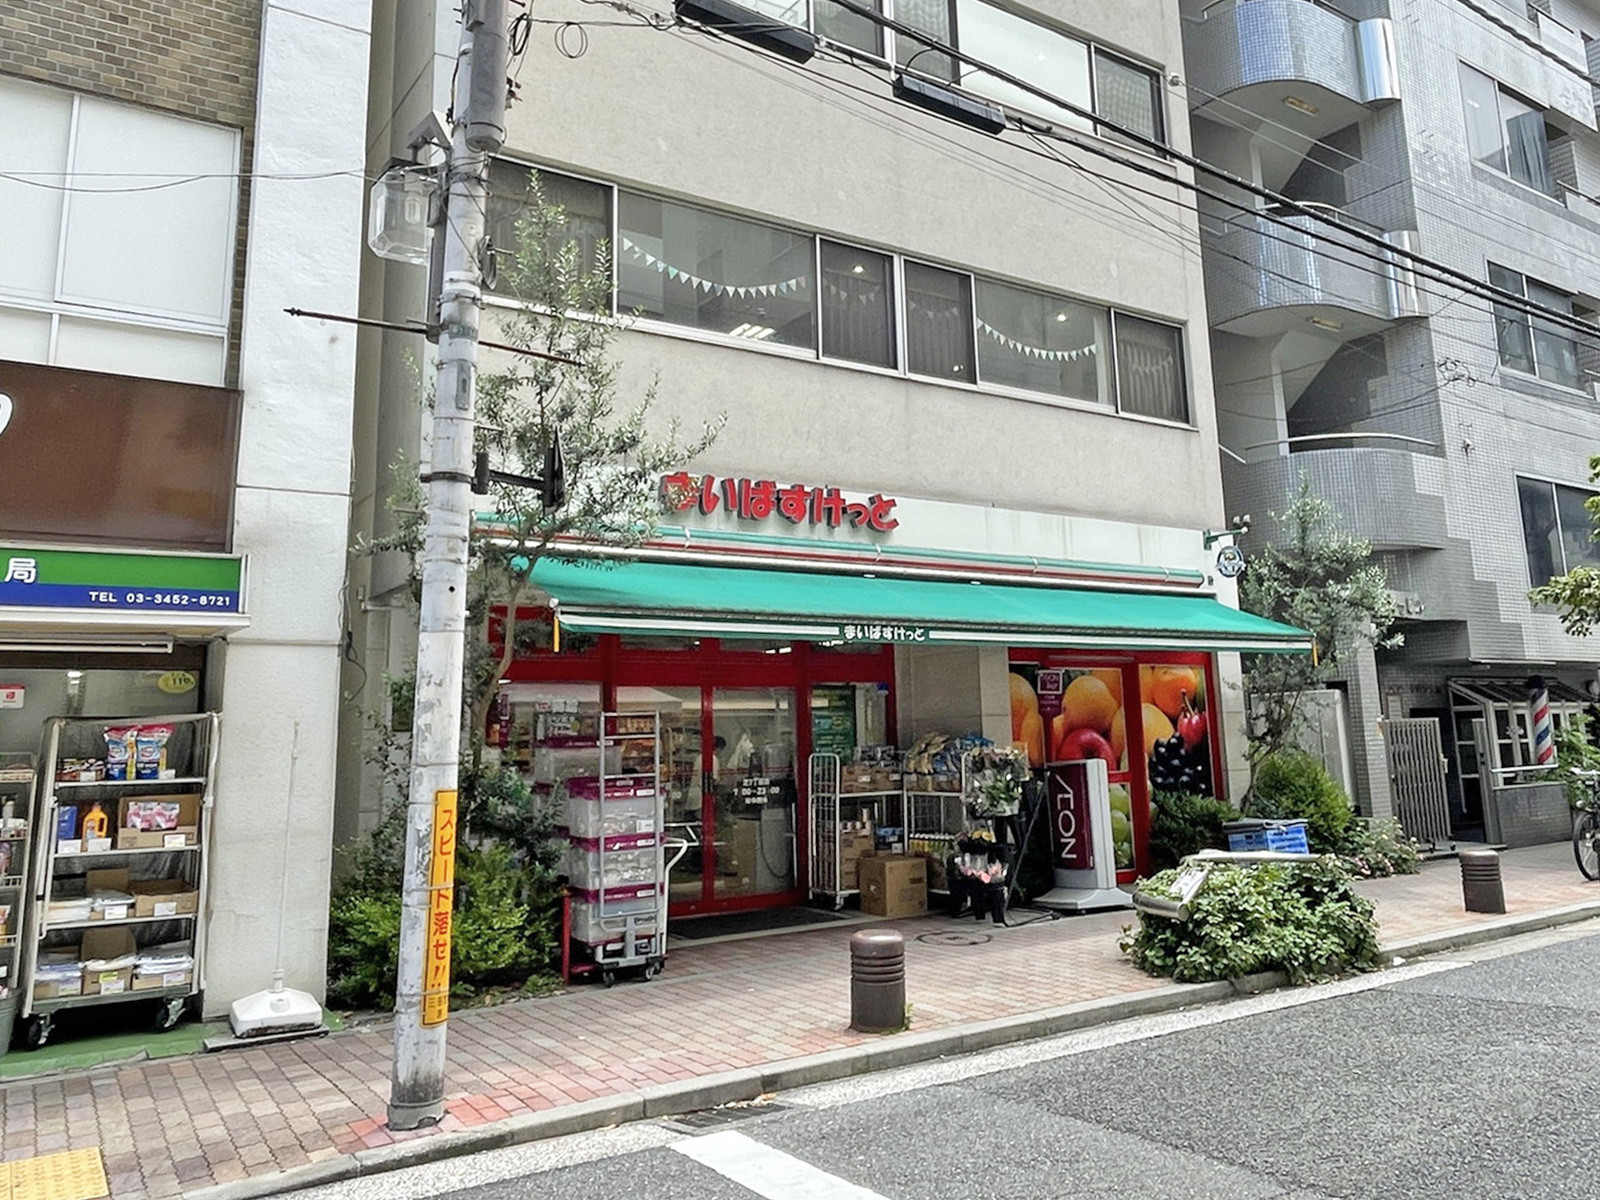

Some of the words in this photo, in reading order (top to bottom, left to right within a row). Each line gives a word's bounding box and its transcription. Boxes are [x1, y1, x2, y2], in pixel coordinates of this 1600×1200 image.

[4, 557, 37, 584] 局
[89, 591, 117, 603] TEL
[126, 592, 230, 606] 03-3452-8721
[843, 625, 926, 641] まいばすけっと
